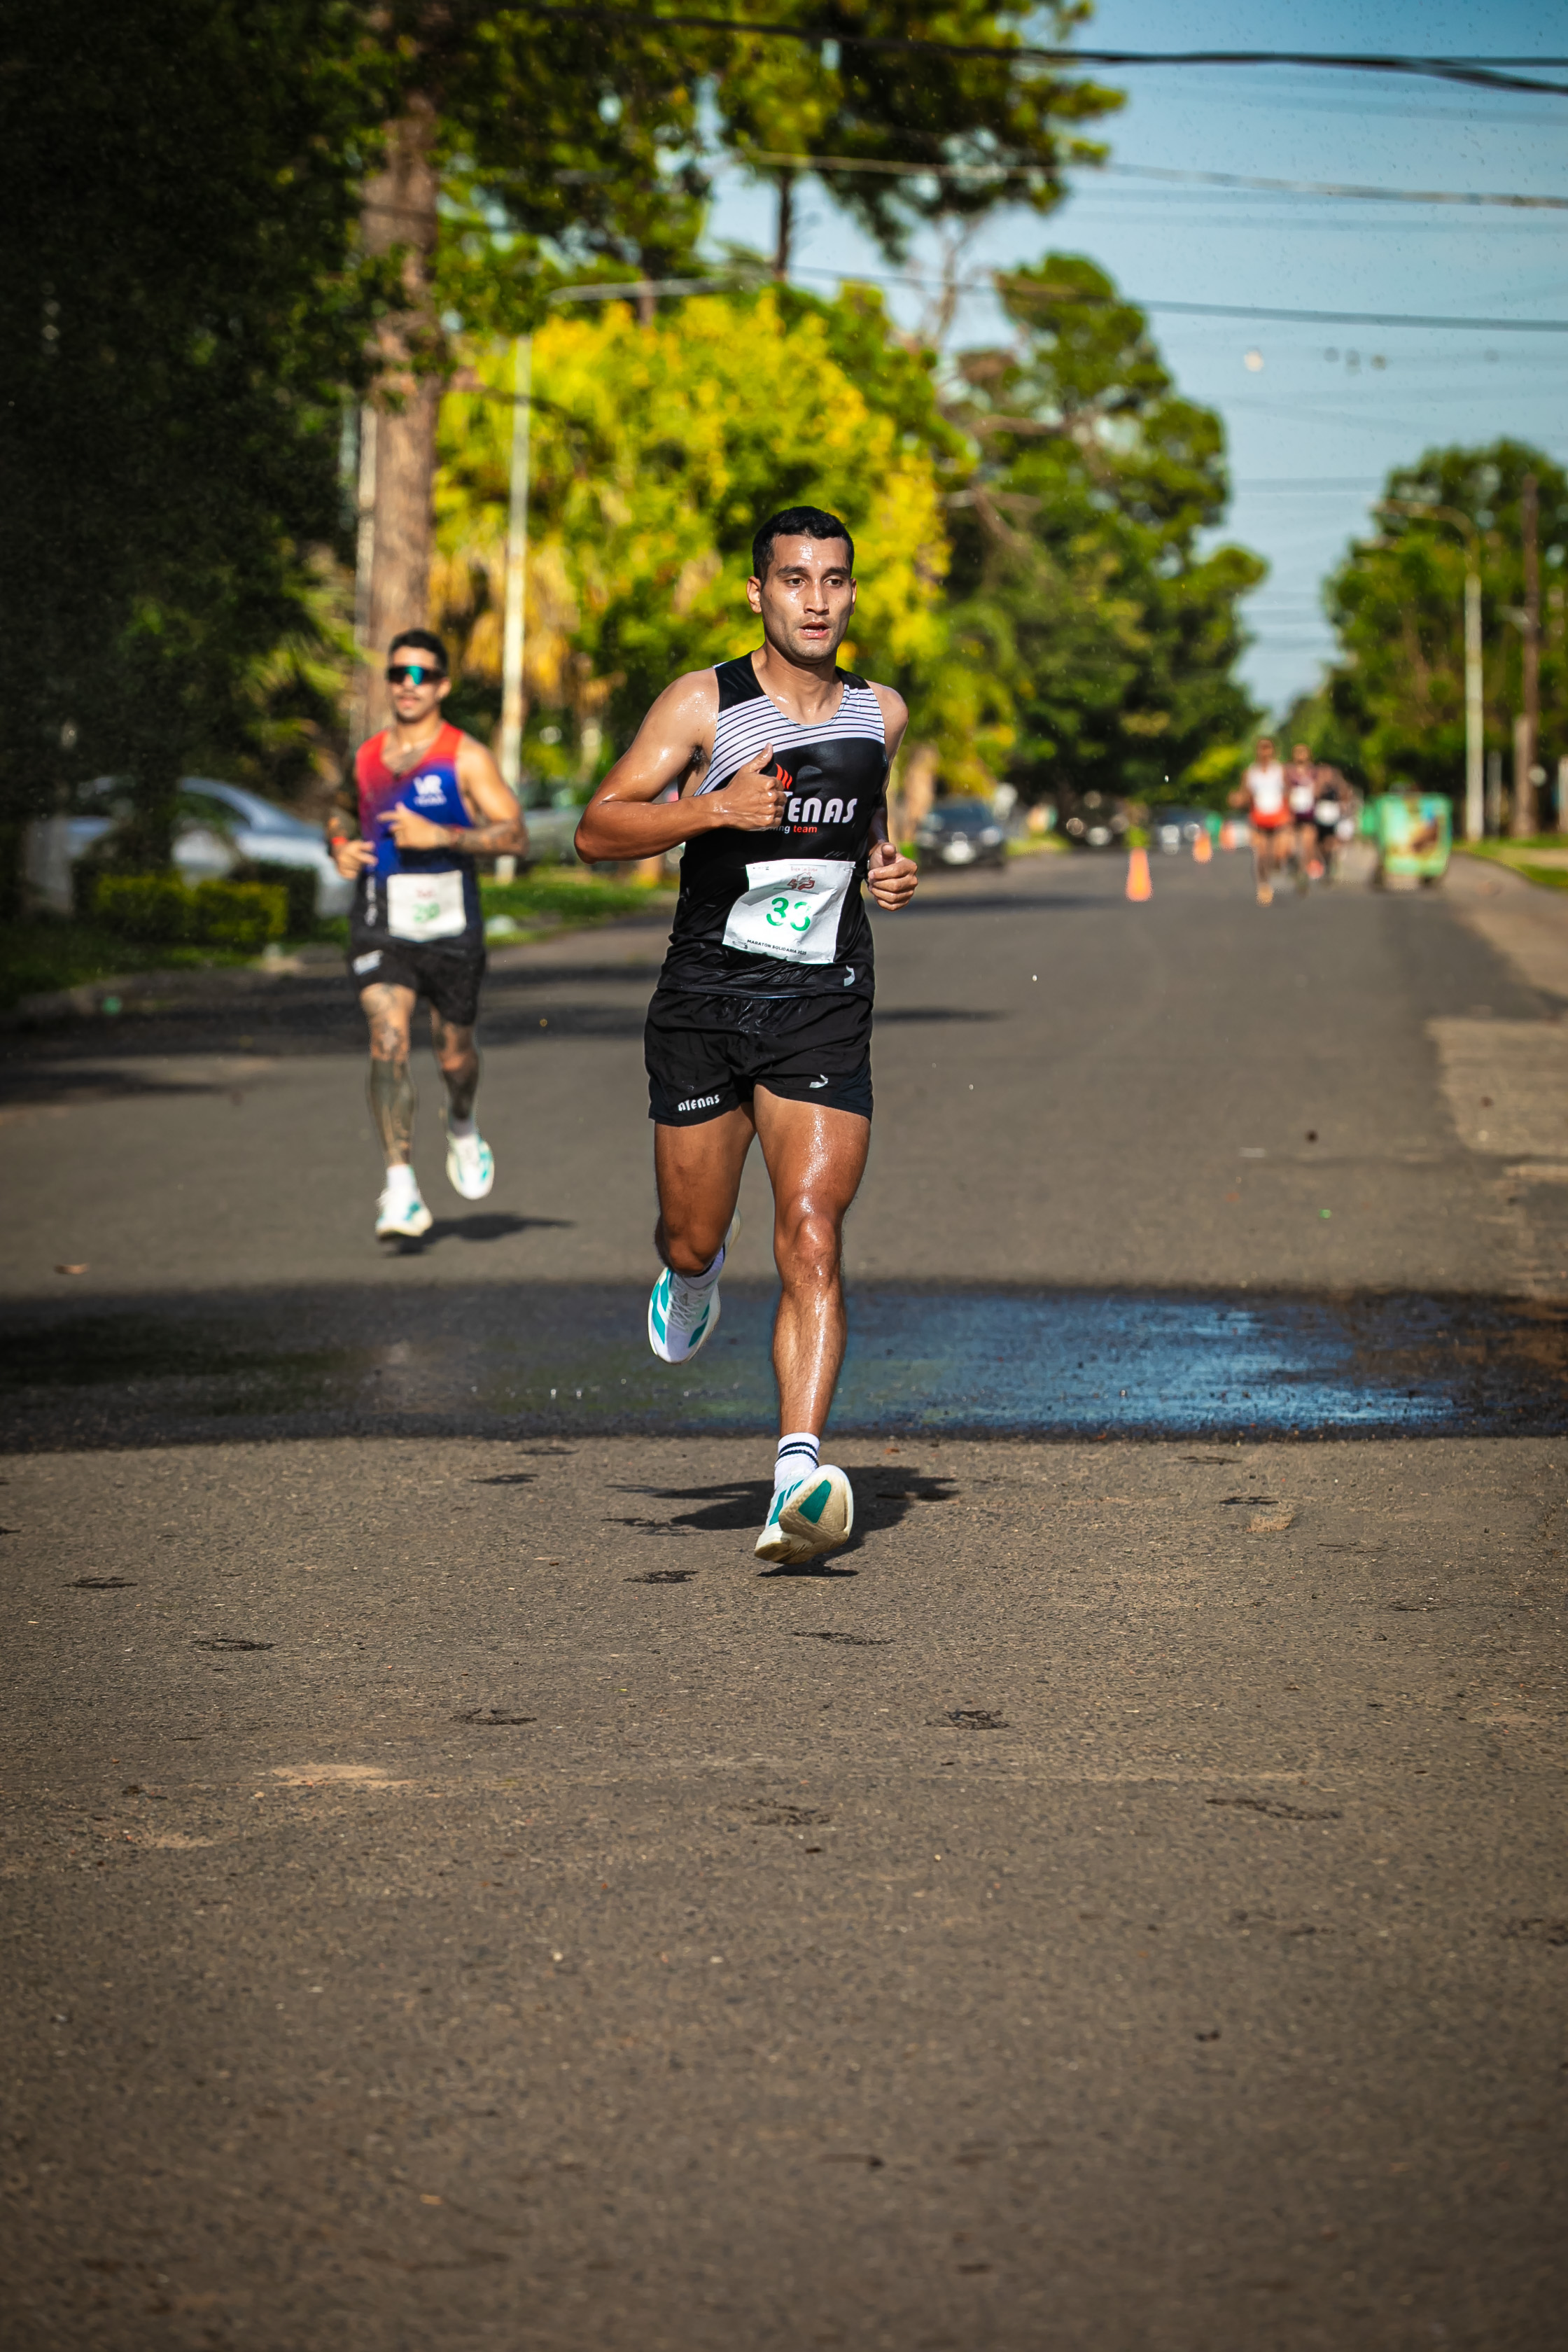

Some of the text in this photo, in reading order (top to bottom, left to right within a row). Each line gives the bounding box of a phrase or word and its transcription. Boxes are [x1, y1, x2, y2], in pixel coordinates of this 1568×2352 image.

[783, 791, 858, 823] ENAS
[793, 825, 818, 833] team
[747, 939, 771, 948] MARATON
[772, 945, 797, 953] SOLIDARIA
[678, 1094, 720, 1112] ATENAS
